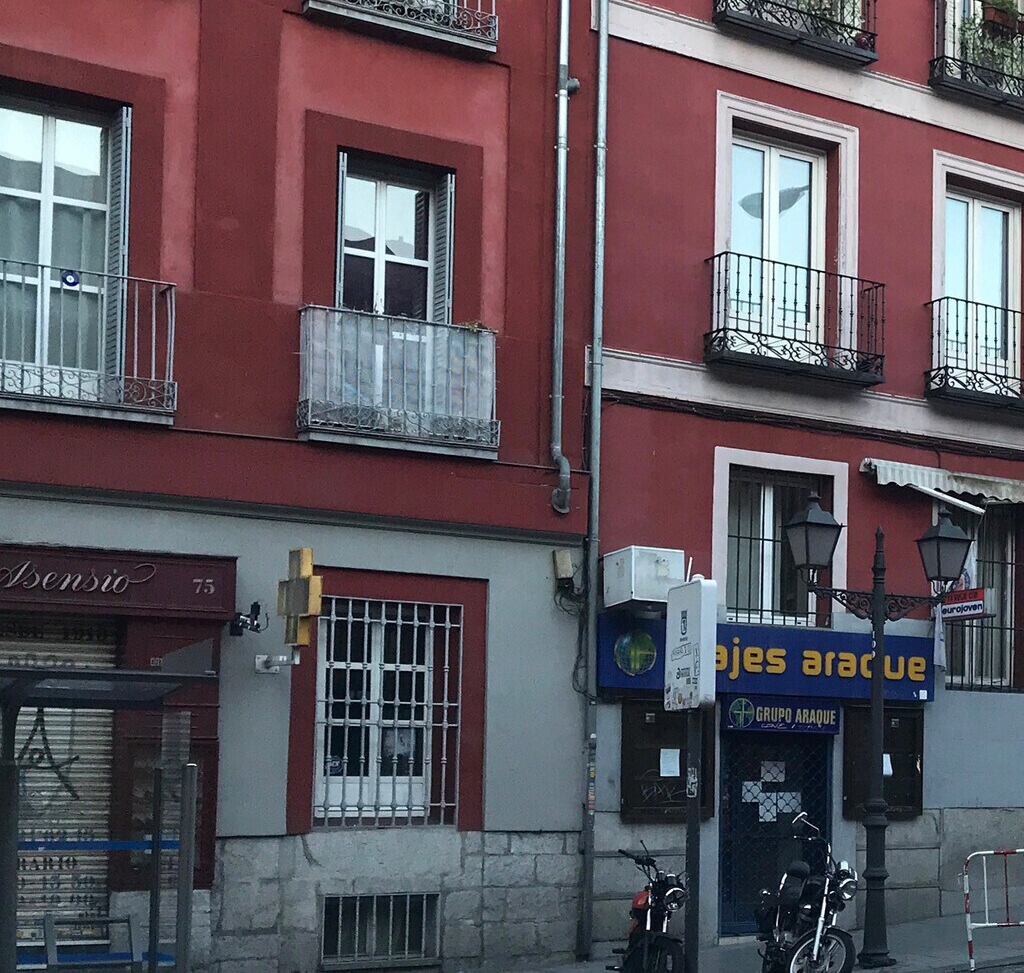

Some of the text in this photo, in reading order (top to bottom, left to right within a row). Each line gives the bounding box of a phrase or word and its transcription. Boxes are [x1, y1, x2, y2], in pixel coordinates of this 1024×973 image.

[192, 578, 216, 595] 75
[941, 603, 983, 615] eurojoven
[716, 637, 787, 680] ajes
[802, 649, 926, 682] araque
[755, 706, 836, 725] GRUPO ARAQUE
[18, 857, 79, 871] RARIO
